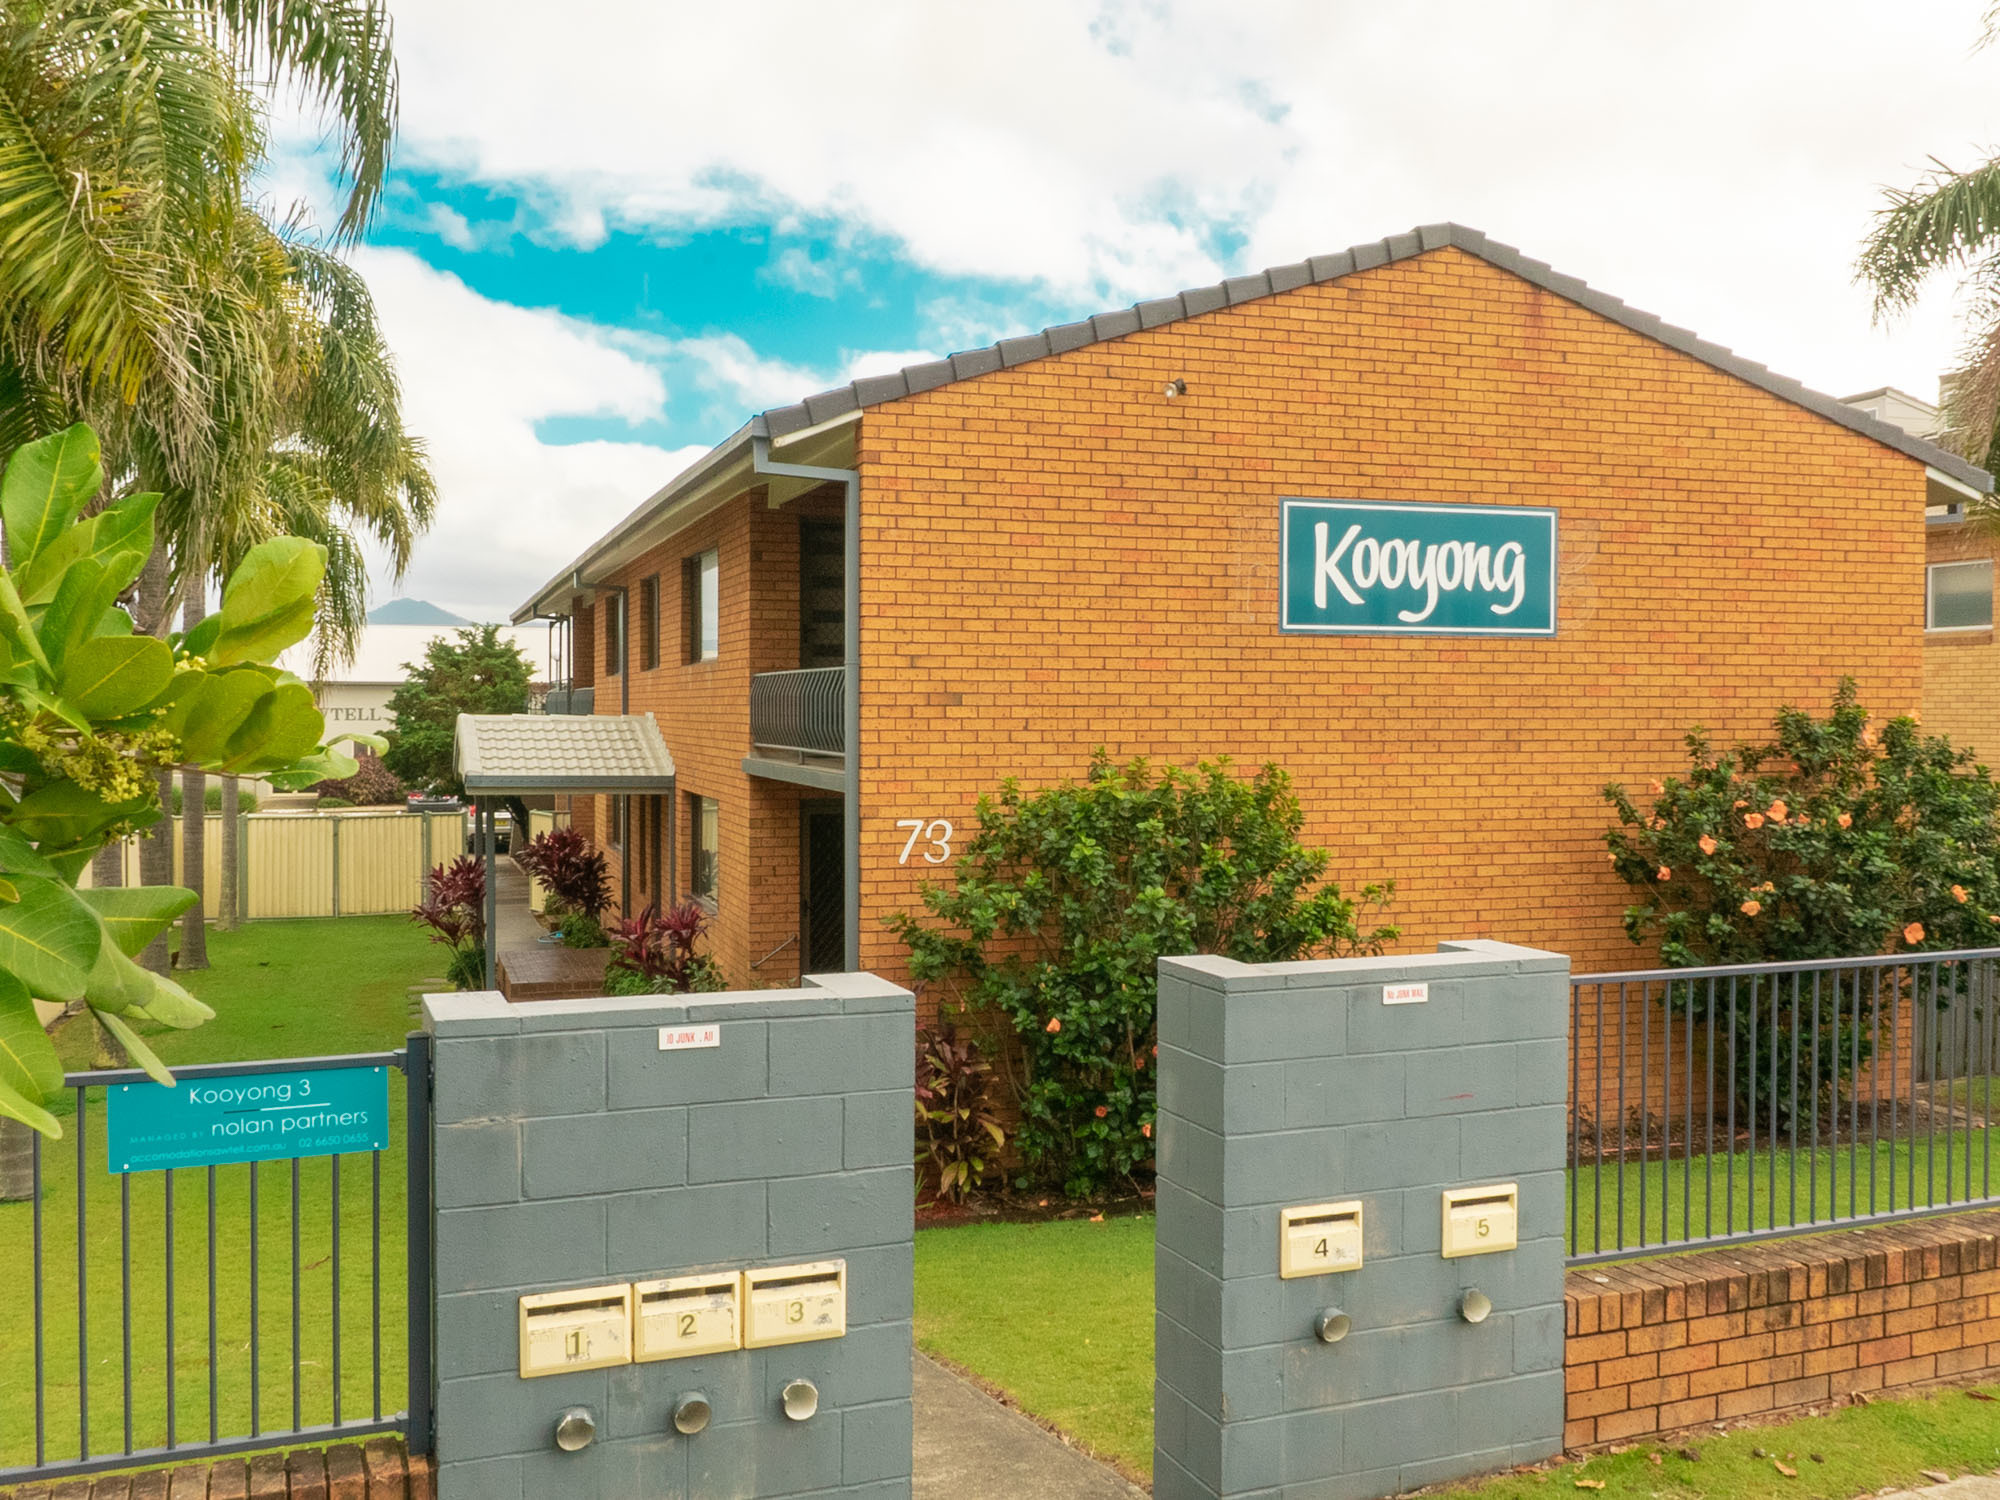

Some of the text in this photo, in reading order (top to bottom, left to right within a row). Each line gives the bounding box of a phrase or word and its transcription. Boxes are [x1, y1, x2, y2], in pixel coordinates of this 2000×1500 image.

[1314, 521, 1525, 623] Kooyong
[896, 819, 953, 865] 73
[676, 1032, 695, 1043] JUNK
[189, 1079, 311, 1106] Kooyong 3
[211, 1111, 369, 1137] nolan partners
[298, 1137, 313, 1149] 02
[1478, 1218, 1490, 1237] 5
[1314, 1238, 1329, 1258] 4
[789, 1301, 804, 1323] 3
[680, 1313, 697, 1336] 2
[568, 1331, 581, 1356] 1
